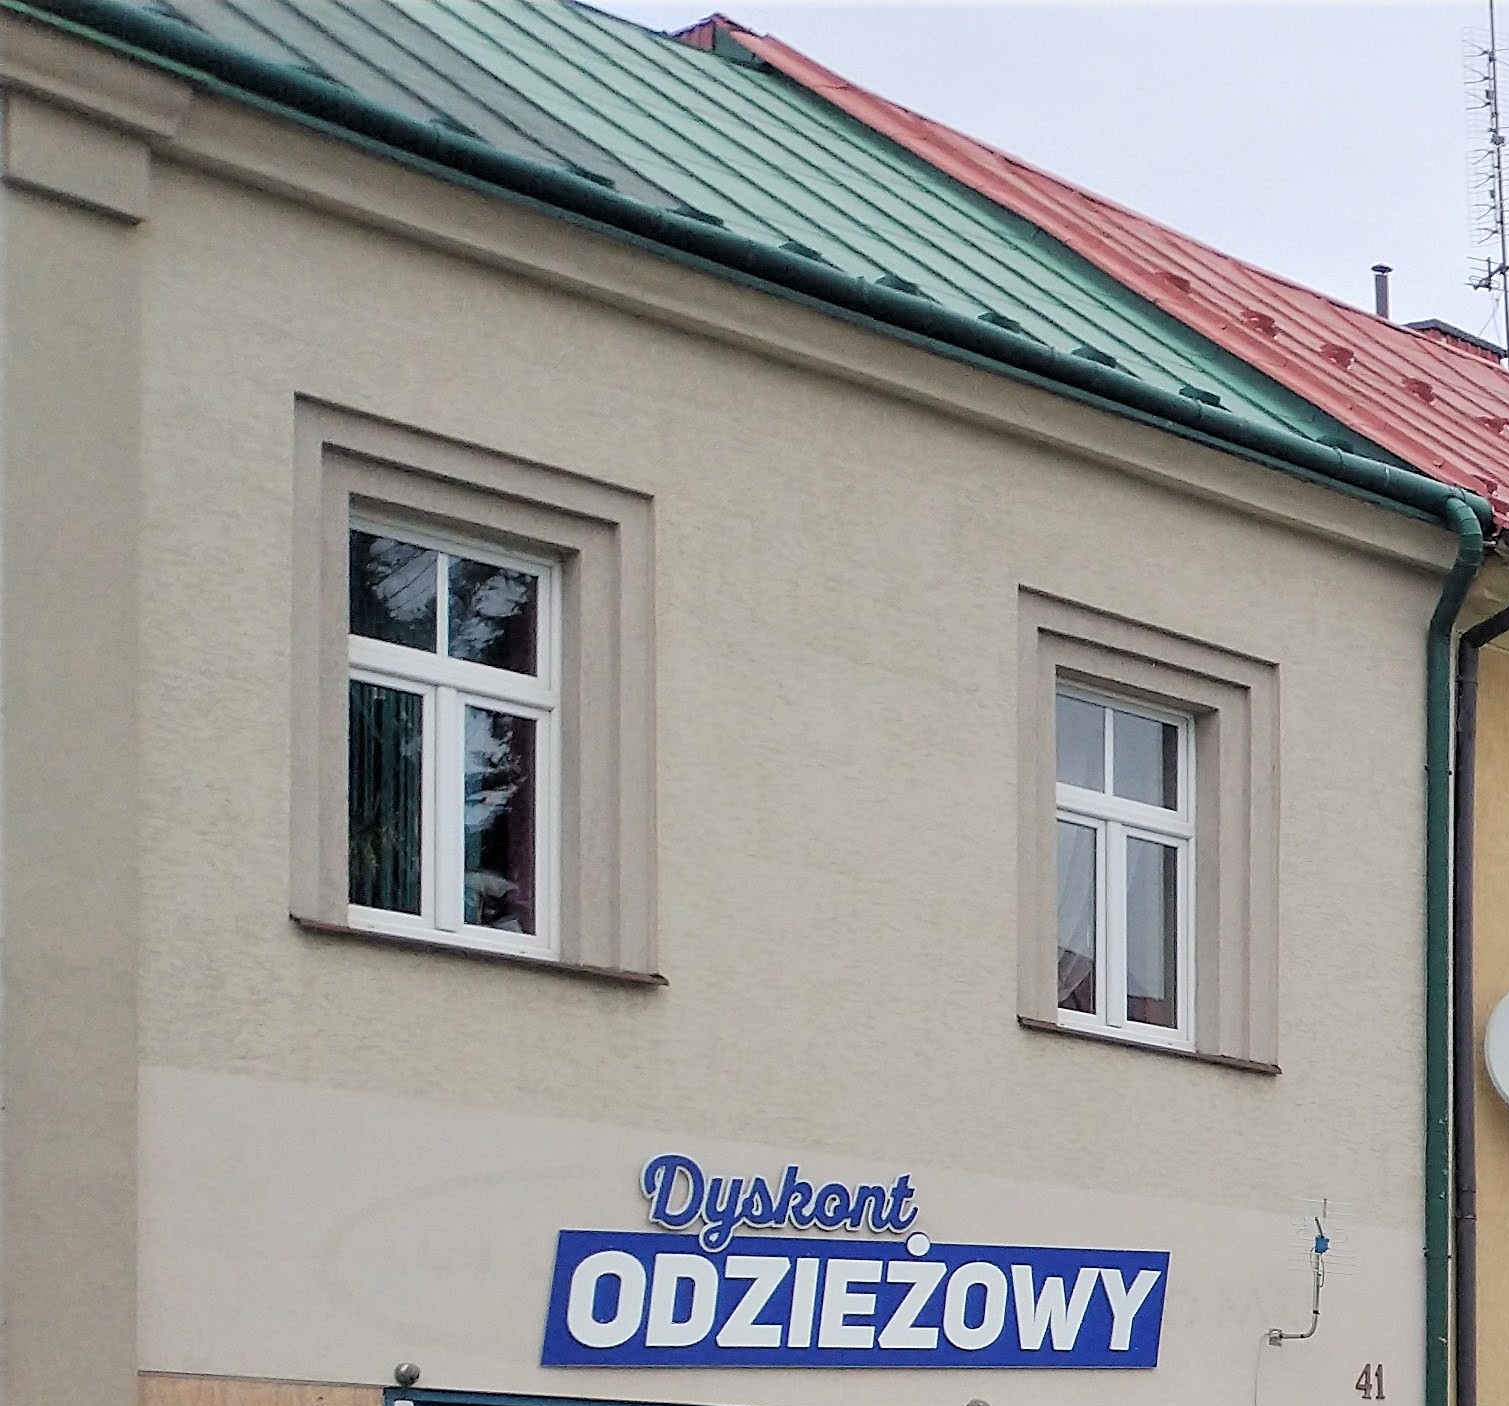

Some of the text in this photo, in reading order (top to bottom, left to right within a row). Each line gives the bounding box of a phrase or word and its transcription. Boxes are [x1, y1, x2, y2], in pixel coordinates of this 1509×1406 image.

[643, 1154, 920, 1251] Dyskont
[566, 1232, 1161, 1352] ODZIEŻOWY
[1355, 1363, 1386, 1400] 41
